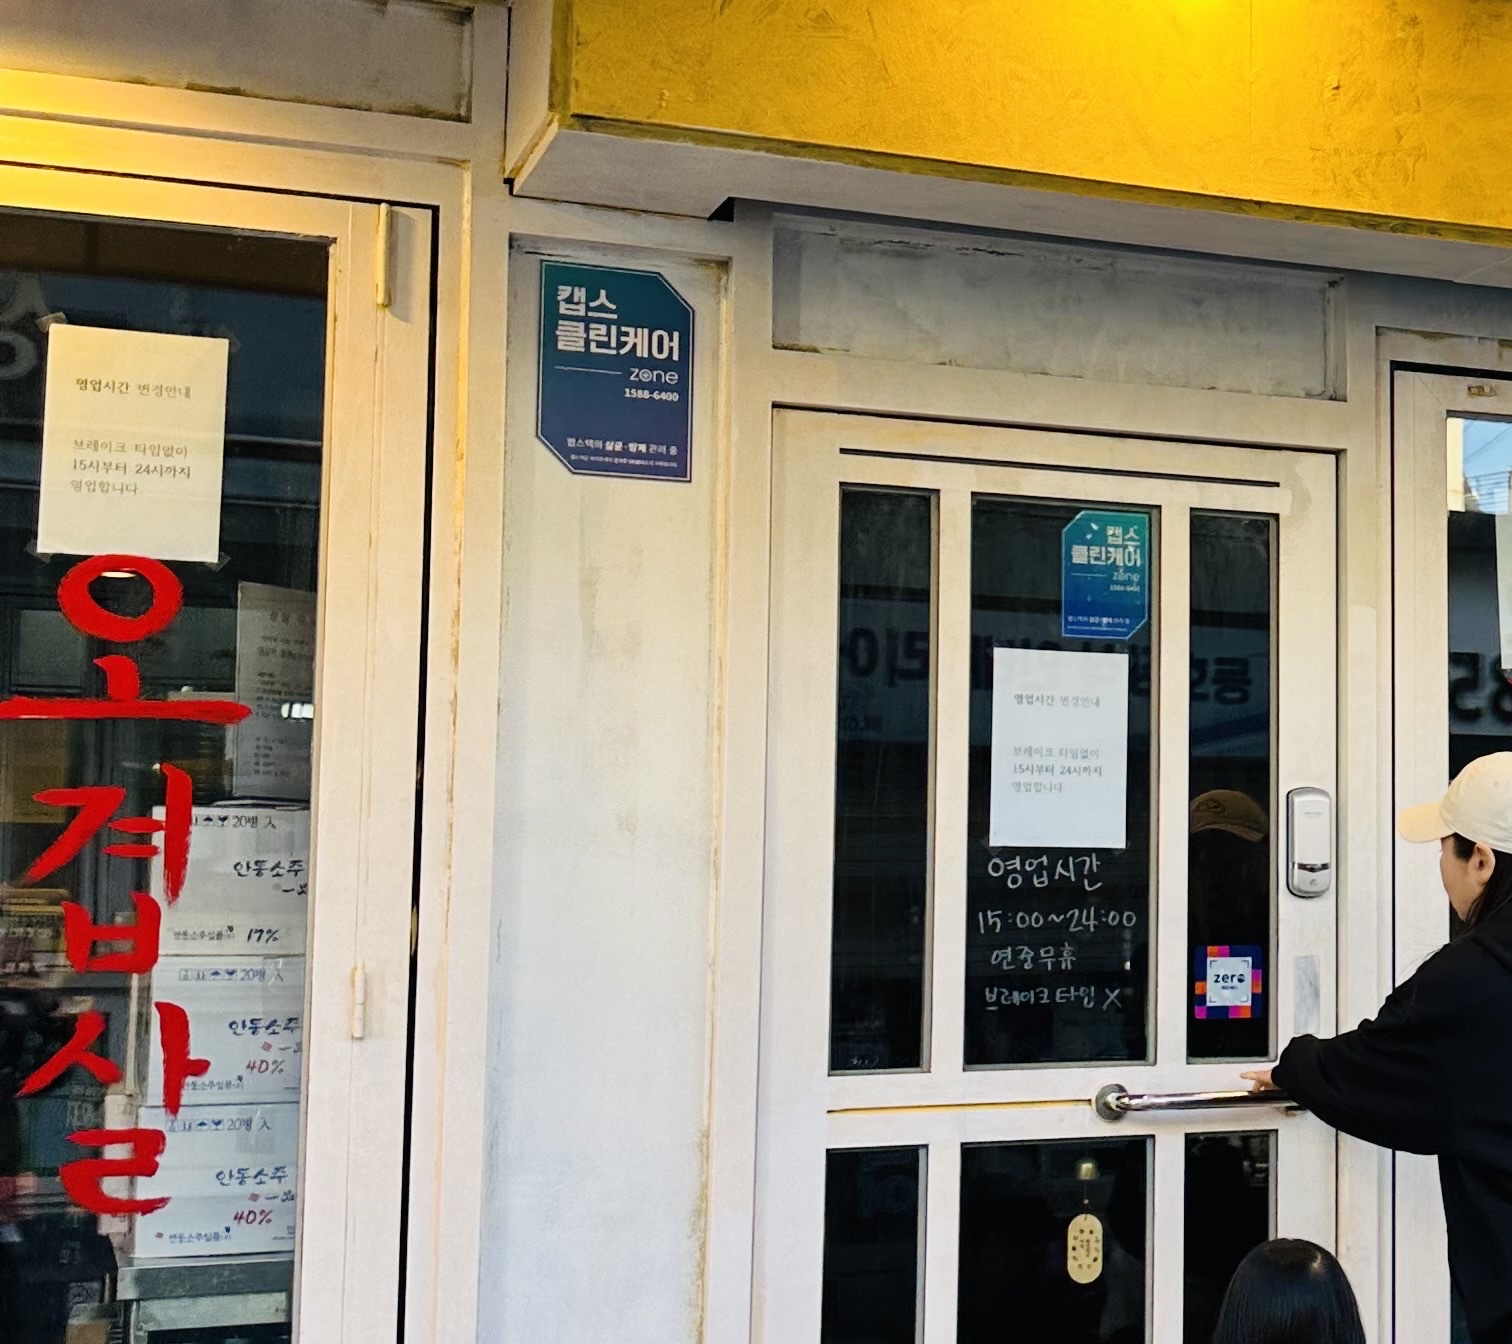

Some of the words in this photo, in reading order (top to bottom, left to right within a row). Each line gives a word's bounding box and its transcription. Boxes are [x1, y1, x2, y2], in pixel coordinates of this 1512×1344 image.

[557, 285, 618, 319] 캡스
[555, 320, 680, 361] 클린케어
[75, 377, 129, 395] 영업시간
[629, 367, 679, 385] zone
[1014, 693, 1054, 706] 영업시간
[233, 859, 306, 878] 안동소주
[987, 852, 1103, 892] 영업시간
[978, 906, 1137, 935] 15:00~24:00
[990, 941, 1077, 972] 연중무휴
[1213, 973, 1246, 984] zero
[216, 1166, 289, 1187] 안동소주
[232, 1208, 273, 1225] 40%
